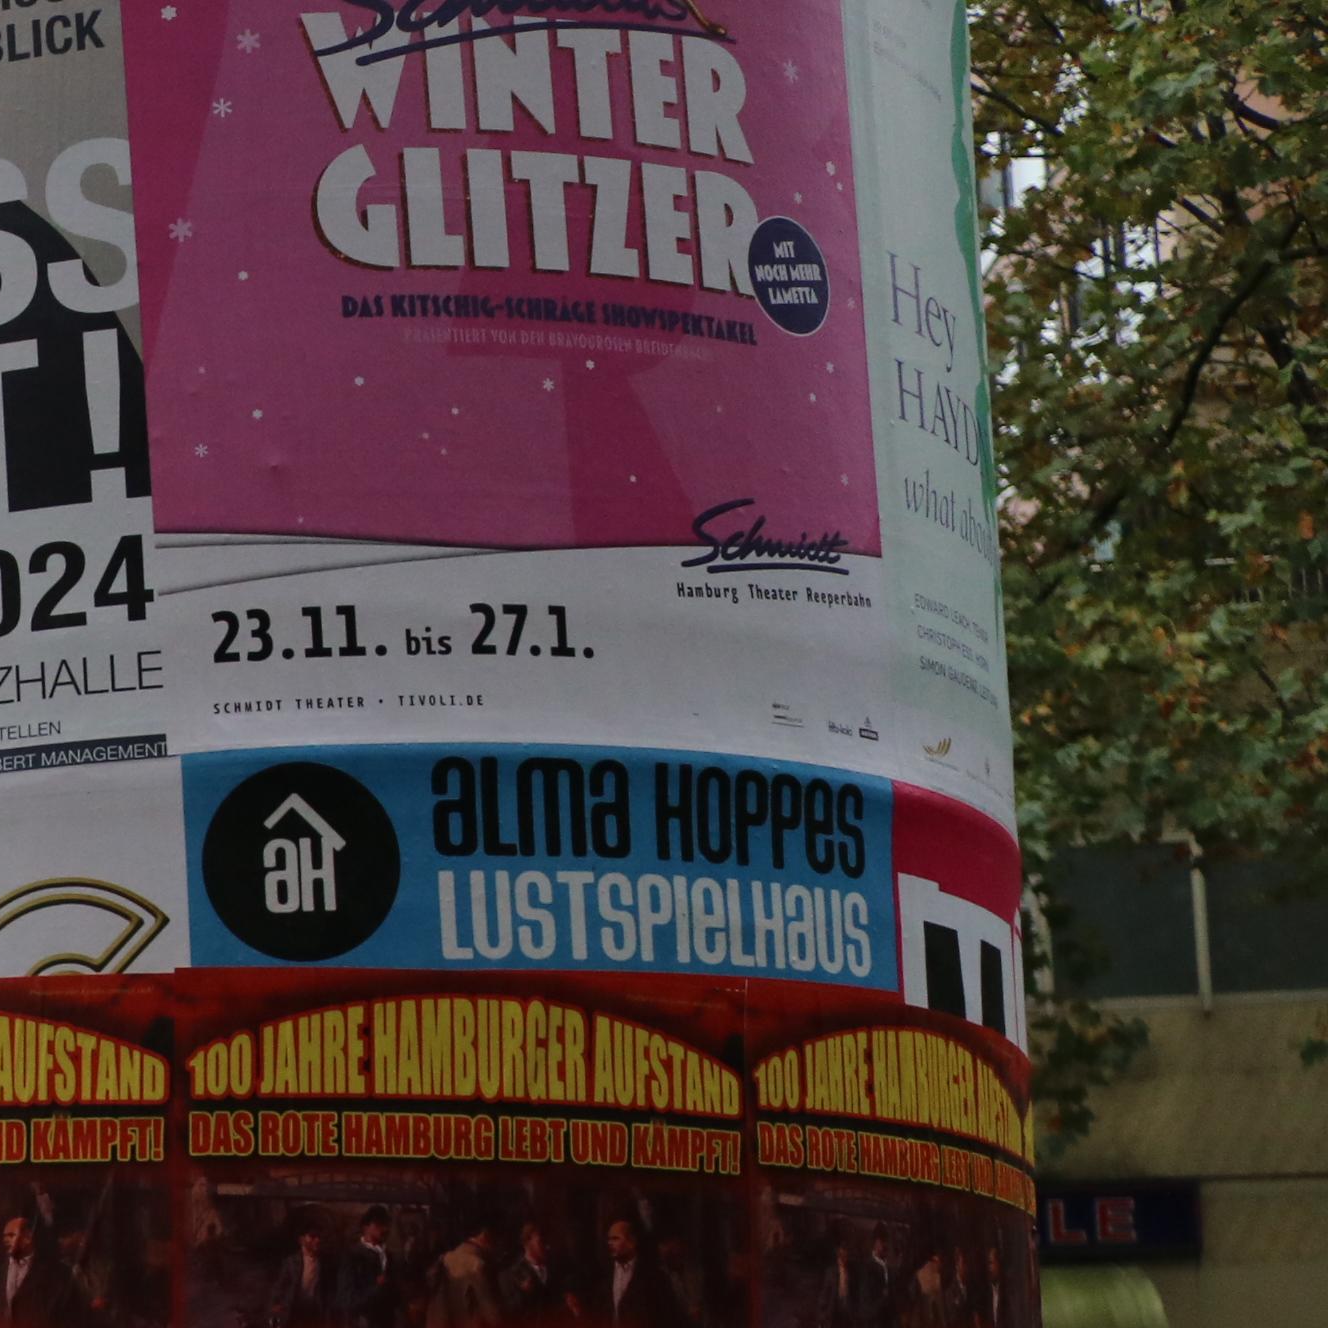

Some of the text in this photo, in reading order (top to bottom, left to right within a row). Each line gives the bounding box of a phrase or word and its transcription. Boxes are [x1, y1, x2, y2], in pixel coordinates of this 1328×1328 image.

[300, 12, 754, 165] WINTER
[311, 146, 759, 300] GLITZER
[774, 240, 795, 259] MIT
[341, 294, 385, 319] DAS
[769, 286, 819, 306] LAMETTA
[888, 251, 956, 374] Hey
[904, 469, 956, 532] what
[676, 582, 872, 609] Hamburg Theater Reeperbahn
[212, 602, 596, 664] 23.11. bis 27.1.
[213, 694, 485, 714] SCHMIDT THEATER TIVOLI.DE
[40, 740, 168, 768] MANAGEMENT
[187, 998, 741, 1117] 100 JAHRE HAMBURGER AUFSTAND
[753, 1048, 801, 1109] 100
[803, 1029, 871, 1116] JAHRE
[30, 1113, 165, 1163] KÄMPFT!
[188, 1109, 742, 1176] DAS ROTE HAMBURG LEBT UND KÄMPFT!
[757, 1121, 805, 1169] DAS
[805, 1125, 859, 1174] ROTE
[857, 1130, 941, 1186] HAMBURG
